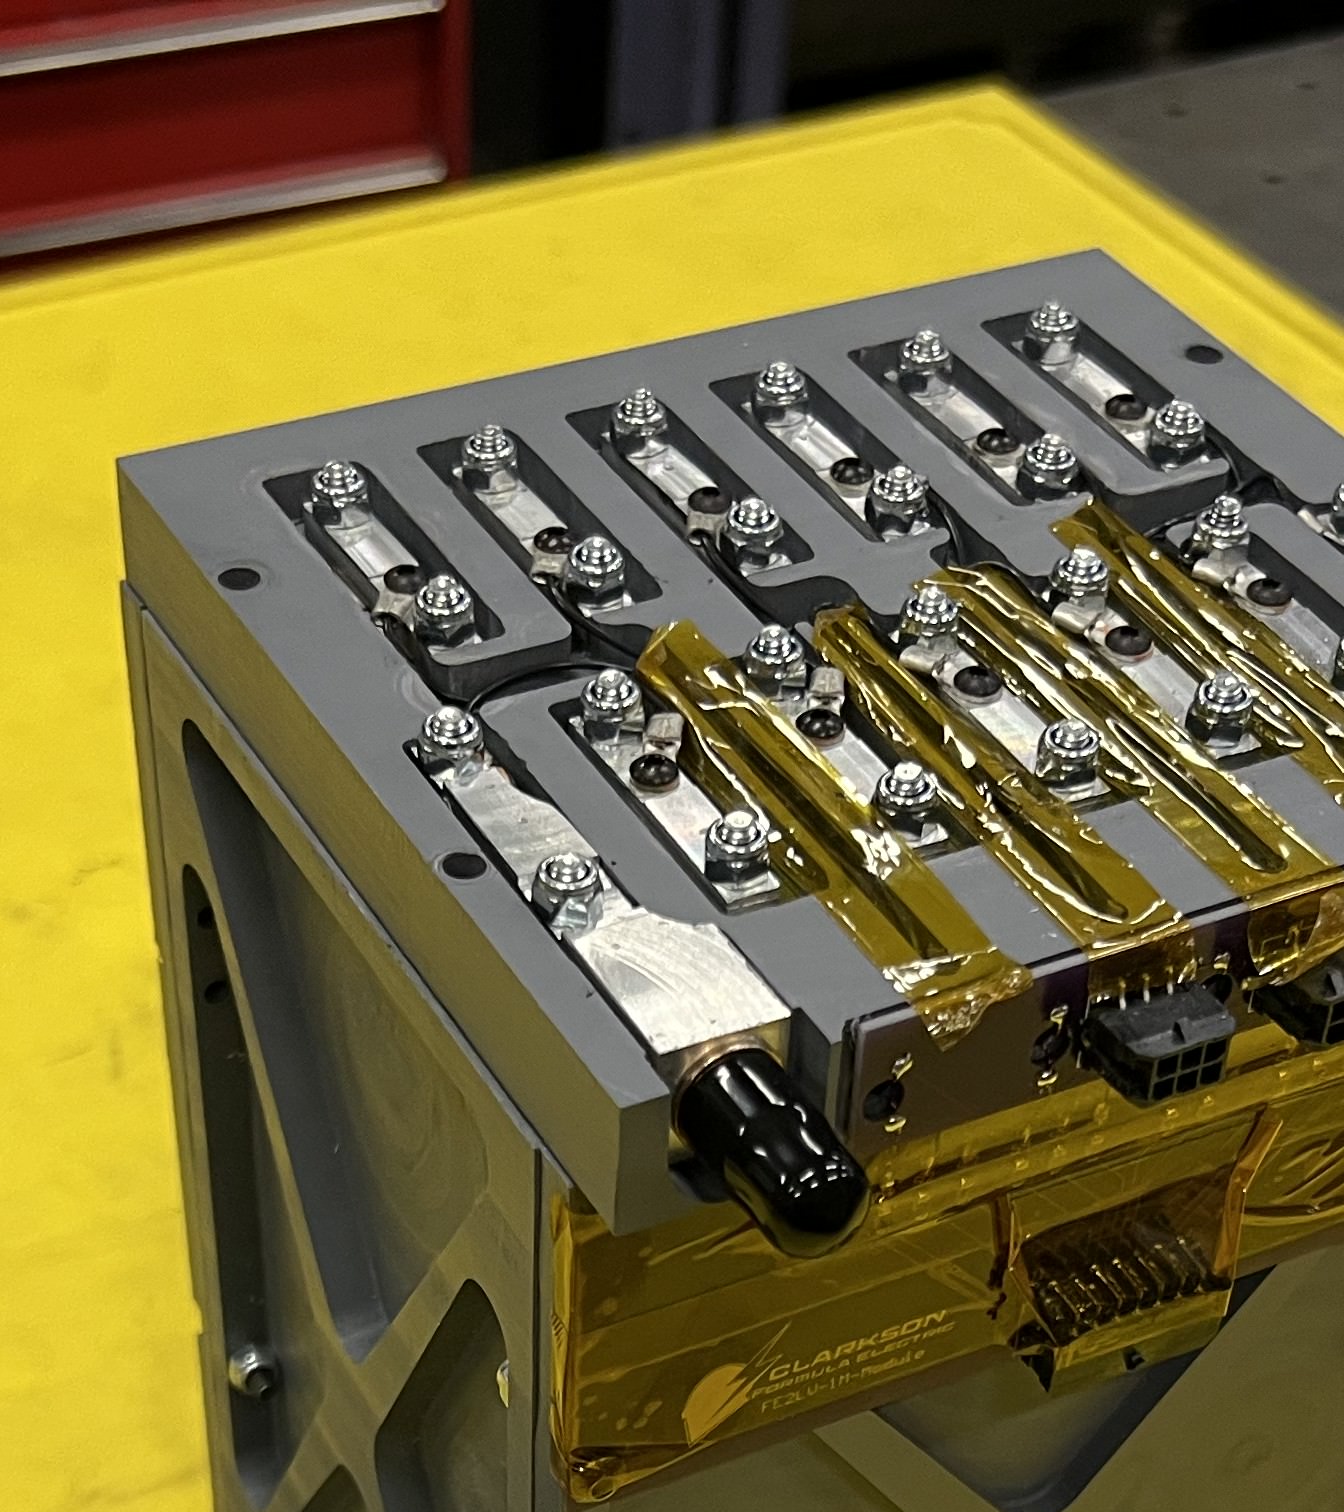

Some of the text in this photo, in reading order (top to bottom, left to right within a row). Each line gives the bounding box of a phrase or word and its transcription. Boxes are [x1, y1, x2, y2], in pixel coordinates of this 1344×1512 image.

[751, 1321, 956, 1399] FORMULA ELECTRIC
[769, 1309, 948, 1381] CLARKSON
